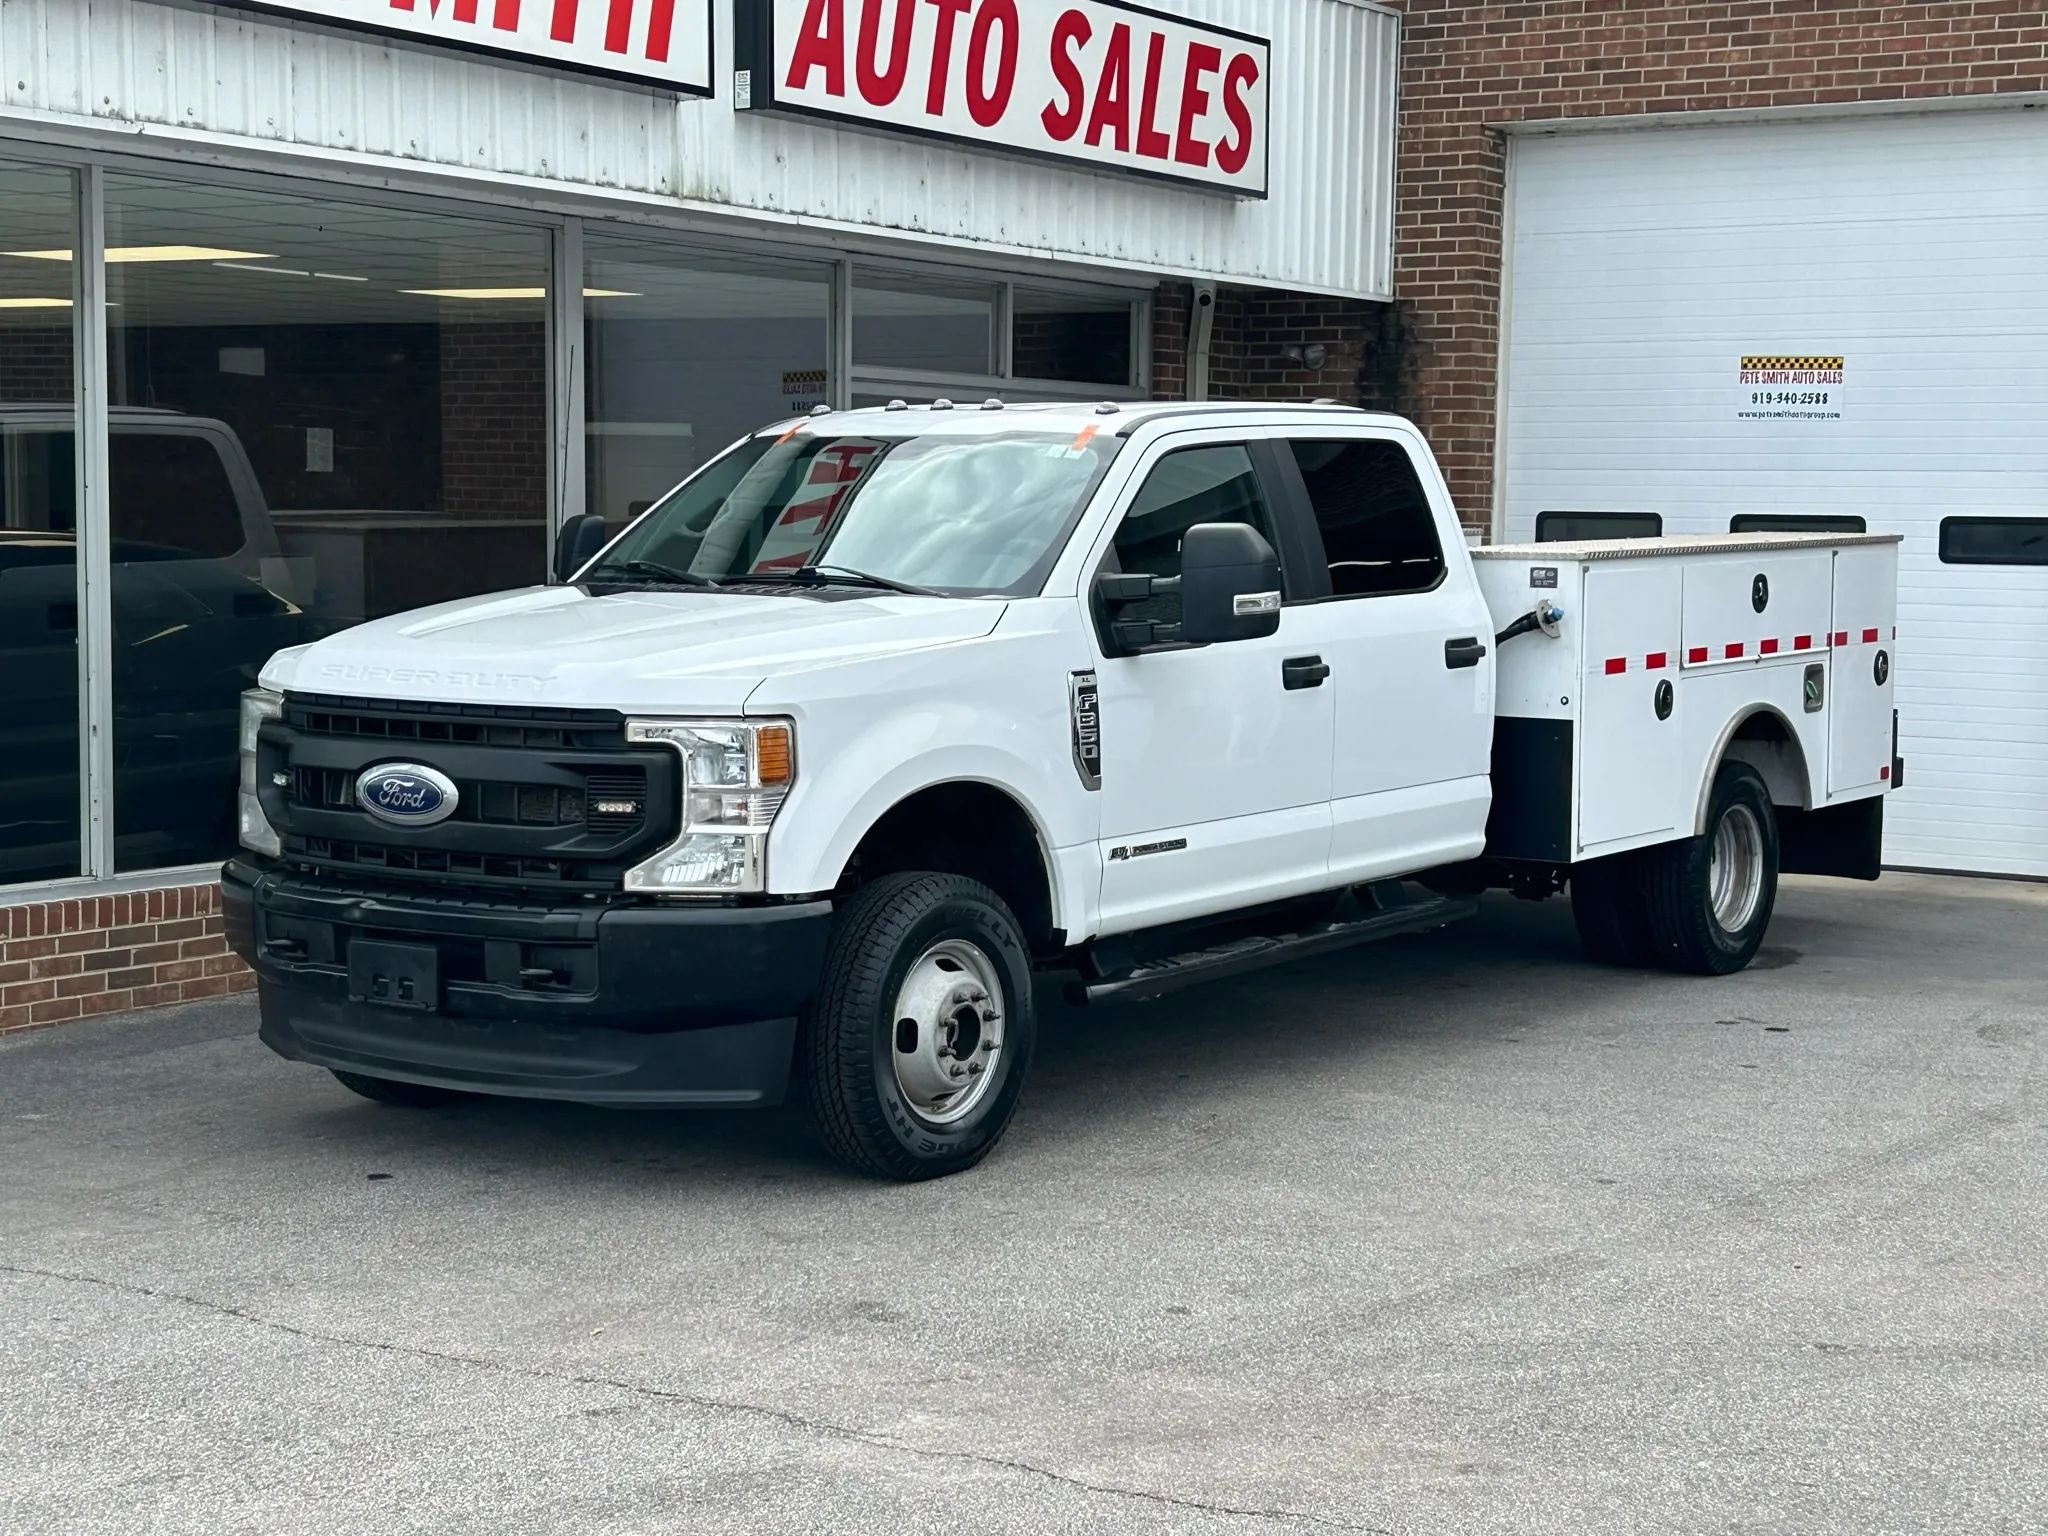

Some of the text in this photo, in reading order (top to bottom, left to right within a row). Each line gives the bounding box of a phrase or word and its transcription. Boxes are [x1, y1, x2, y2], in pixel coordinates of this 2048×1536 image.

[785, 0, 1020, 128] AUTO
[1040, 8, 1260, 175] SALES
[1739, 371, 1843, 384] PETE SMITH AUTO SALES
[1751, 392, 1829, 404] 919-340-2588
[320, 663, 559, 691] SUPER DUTY
[378, 778, 427, 809] Ford
